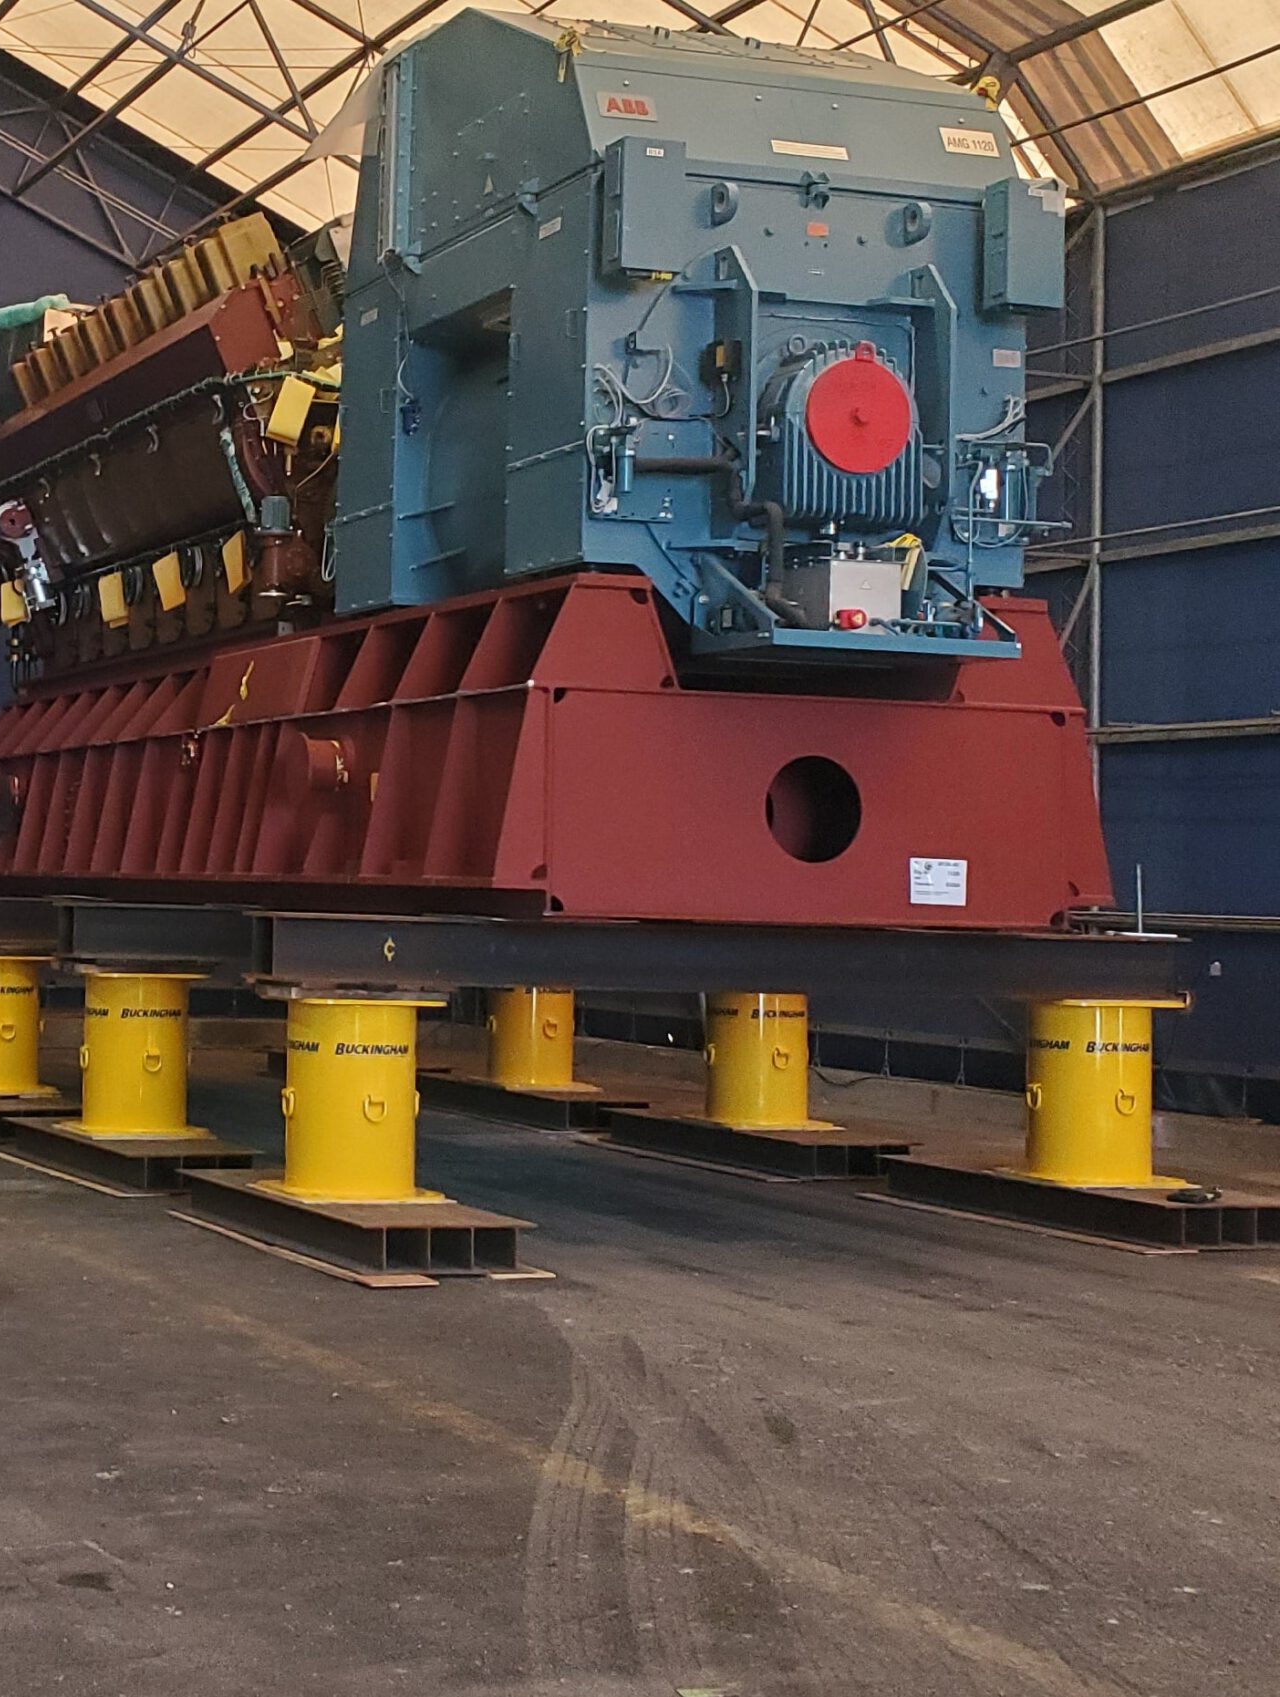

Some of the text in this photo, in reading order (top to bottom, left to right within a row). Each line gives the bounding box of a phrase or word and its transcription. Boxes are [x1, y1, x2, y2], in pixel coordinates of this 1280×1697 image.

[606, 97, 649, 116] ABB
[947, 136, 995, 152] AMG 1120
[121, 1008, 181, 1018] BUCKINGHAM
[335, 1043, 409, 1055] BUCKINGHAM
